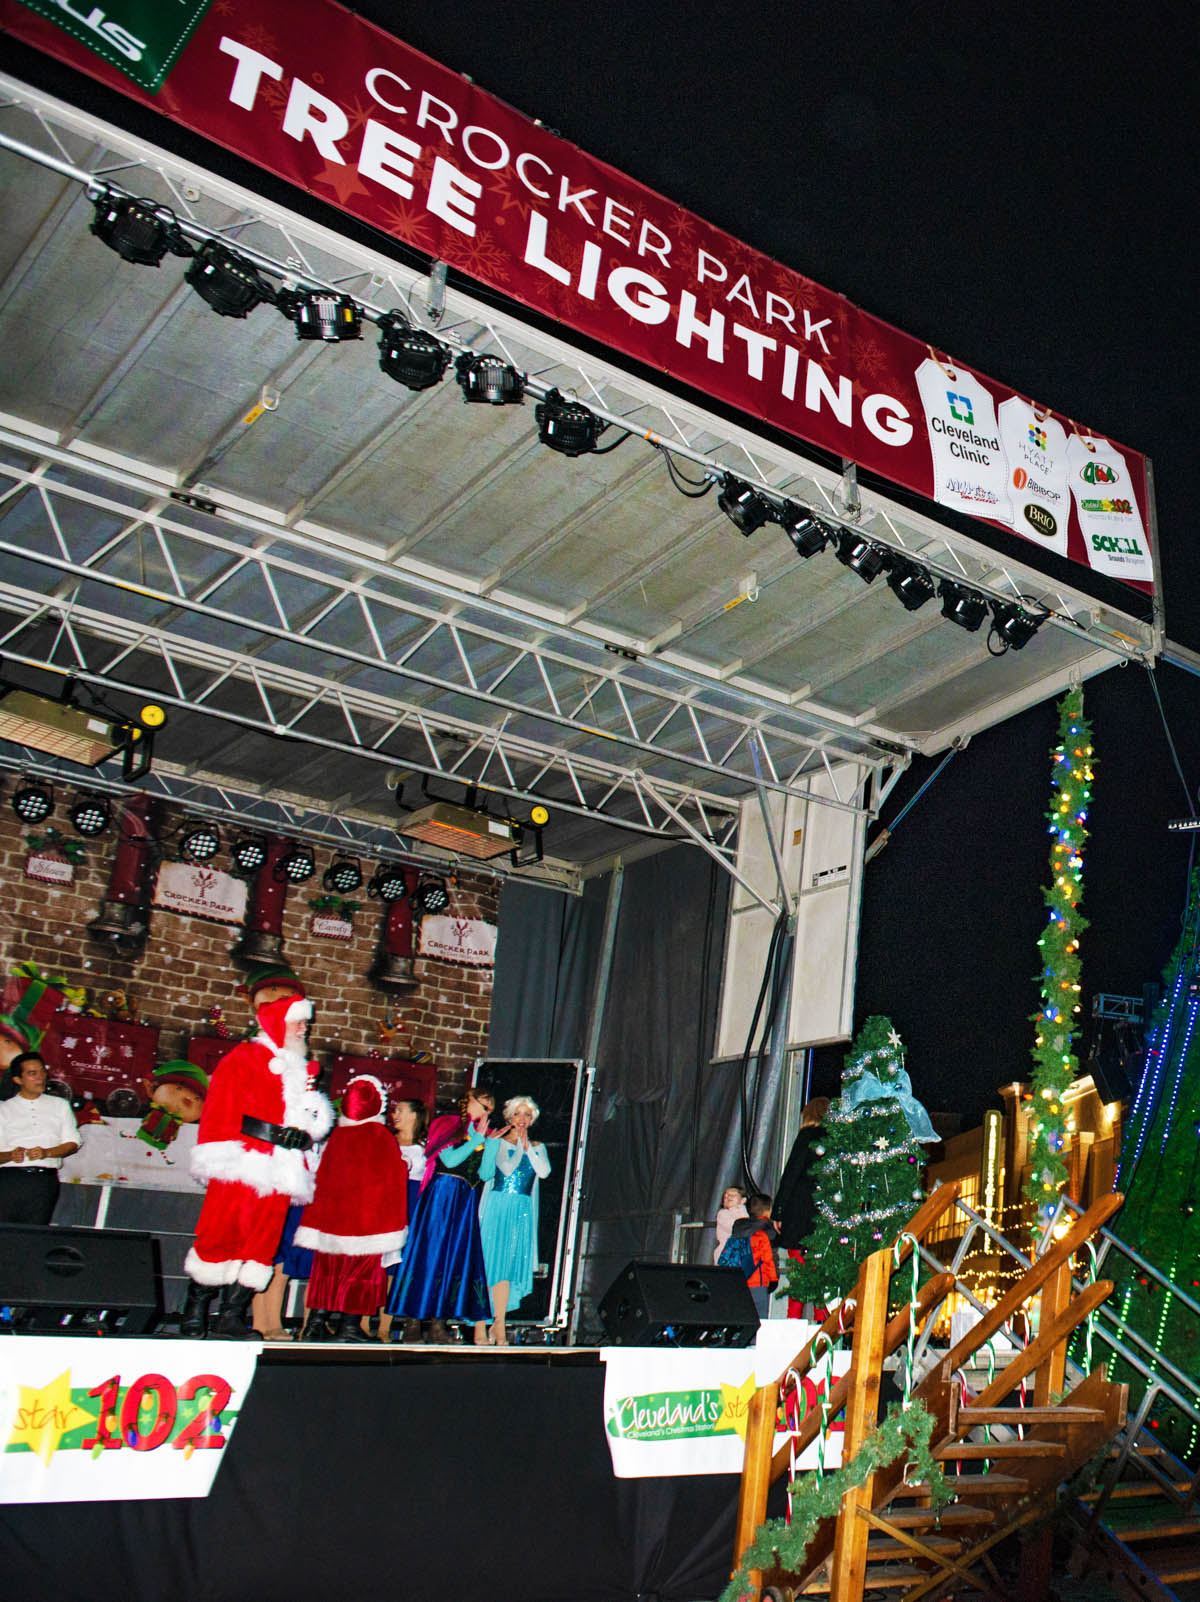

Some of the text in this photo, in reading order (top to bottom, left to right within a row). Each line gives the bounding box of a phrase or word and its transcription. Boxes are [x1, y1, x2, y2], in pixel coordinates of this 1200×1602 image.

[364, 67, 833, 355] CROCKER PARK
[218, 35, 914, 447] TREE LIGHTING
[931, 417, 1000, 452] Cleveland
[950, 442, 990, 466] Clinic
[1018, 440, 1055, 468] HYATT
[1024, 453, 1050, 476] PLACE
[1027, 478, 1061, 501] BIBIBOP
[1029, 505, 1054, 530] BRIO
[163, 890, 208, 907] CROCKER
[210, 901, 235, 913] PARK
[427, 940, 465, 954] CROCKER
[467, 948, 490, 956] PARK
[13, 1373, 232, 1452] star 102
[618, 1391, 719, 1432] Cleveland's
